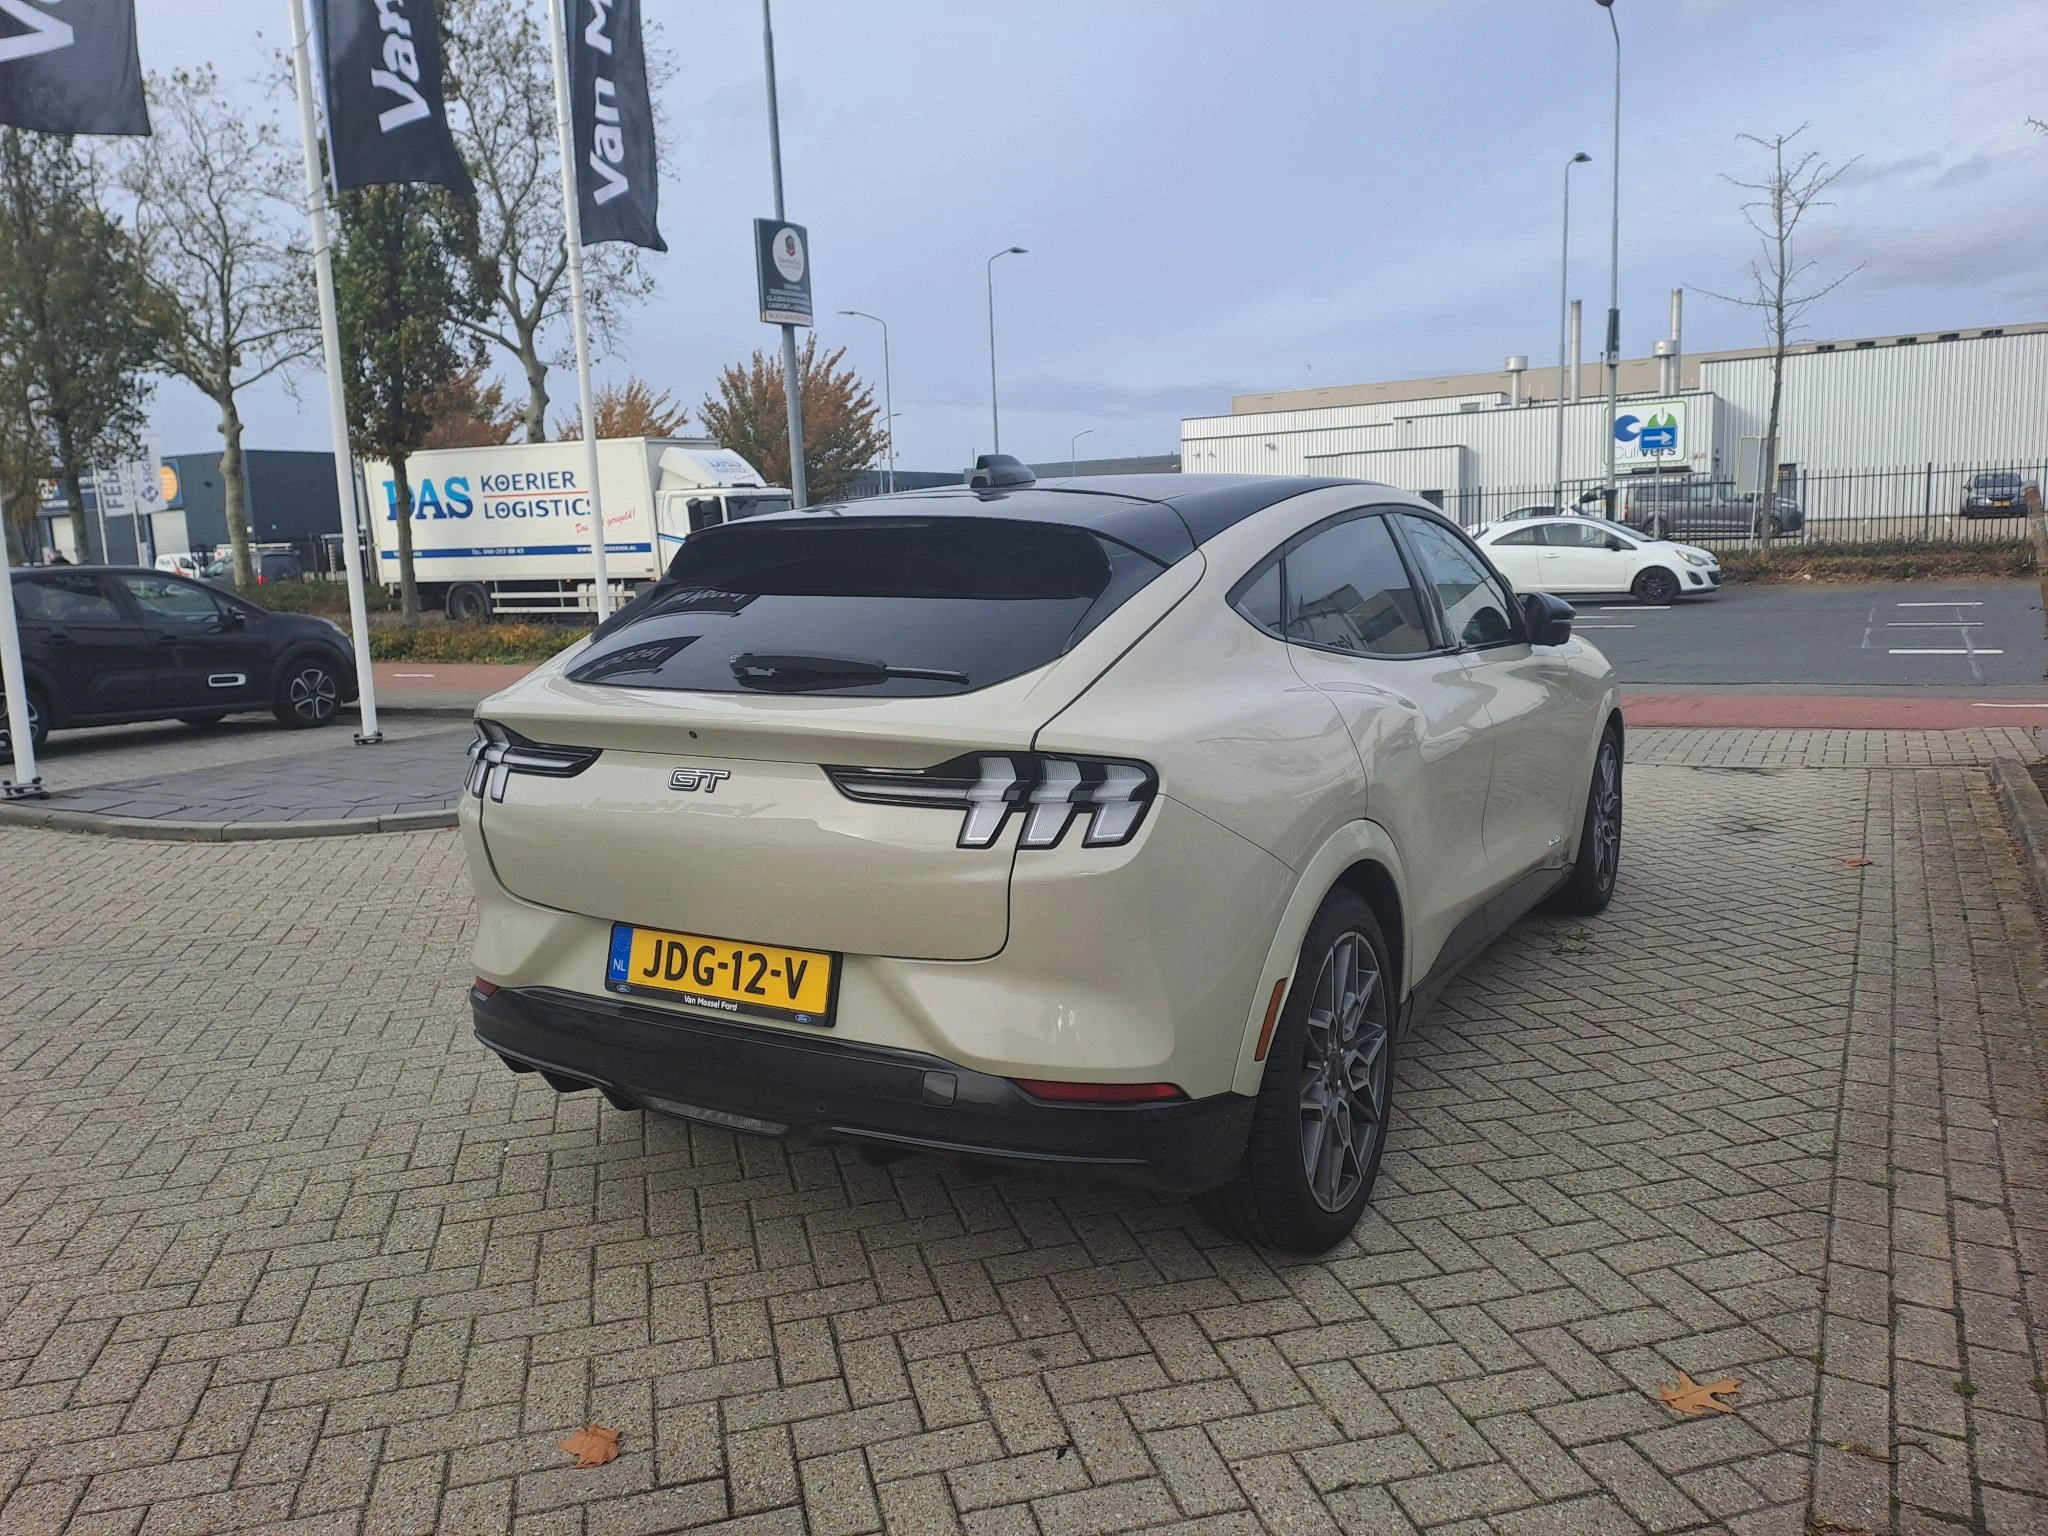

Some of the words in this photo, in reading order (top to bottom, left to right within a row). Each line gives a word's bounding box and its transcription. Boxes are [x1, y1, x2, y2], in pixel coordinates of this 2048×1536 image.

[371, 0, 431, 133] Van
[590, 76, 629, 206] Van
[382, 476, 474, 521] DAS
[480, 471, 576, 493] KOERIER
[668, 767, 731, 794] GT
[613, 958, 627, 972] NL
[643, 939, 808, 1000] JDG-12-V
[684, 994, 696, 1005] Van
[697, 997, 721, 1009] Mossel
[721, 1001, 738, 1012] Ford
